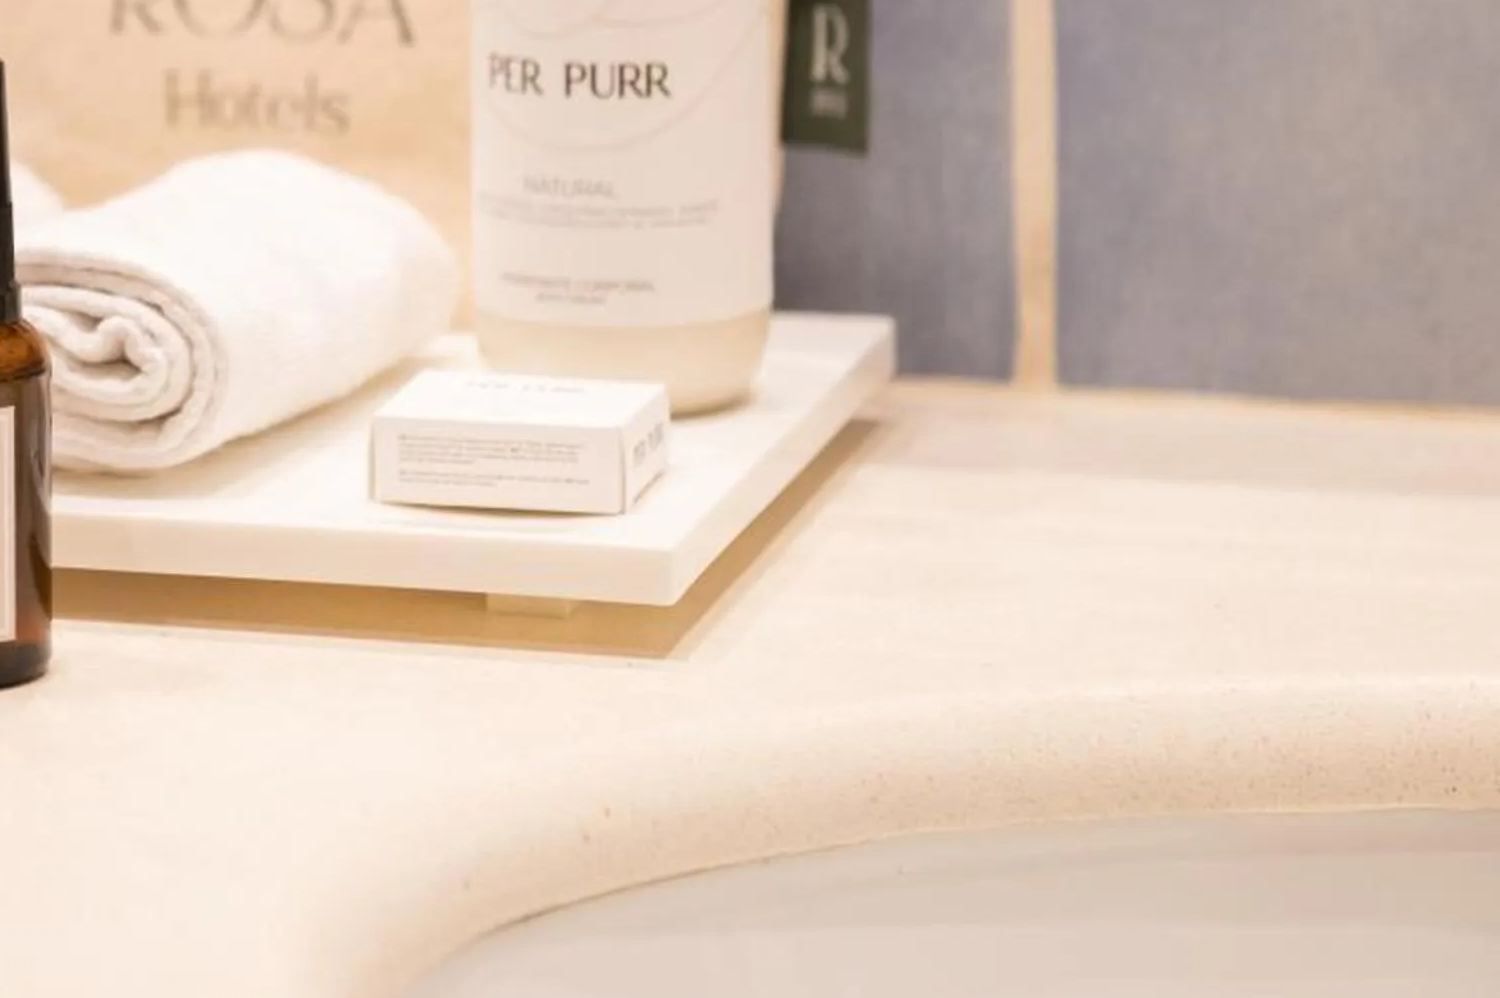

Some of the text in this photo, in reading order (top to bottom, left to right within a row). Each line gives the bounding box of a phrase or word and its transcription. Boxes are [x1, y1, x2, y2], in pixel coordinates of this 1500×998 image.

[487, 50, 673, 100] PER PURR
[810, 3, 851, 85] R
[163, 67, 352, 137] Hotels
